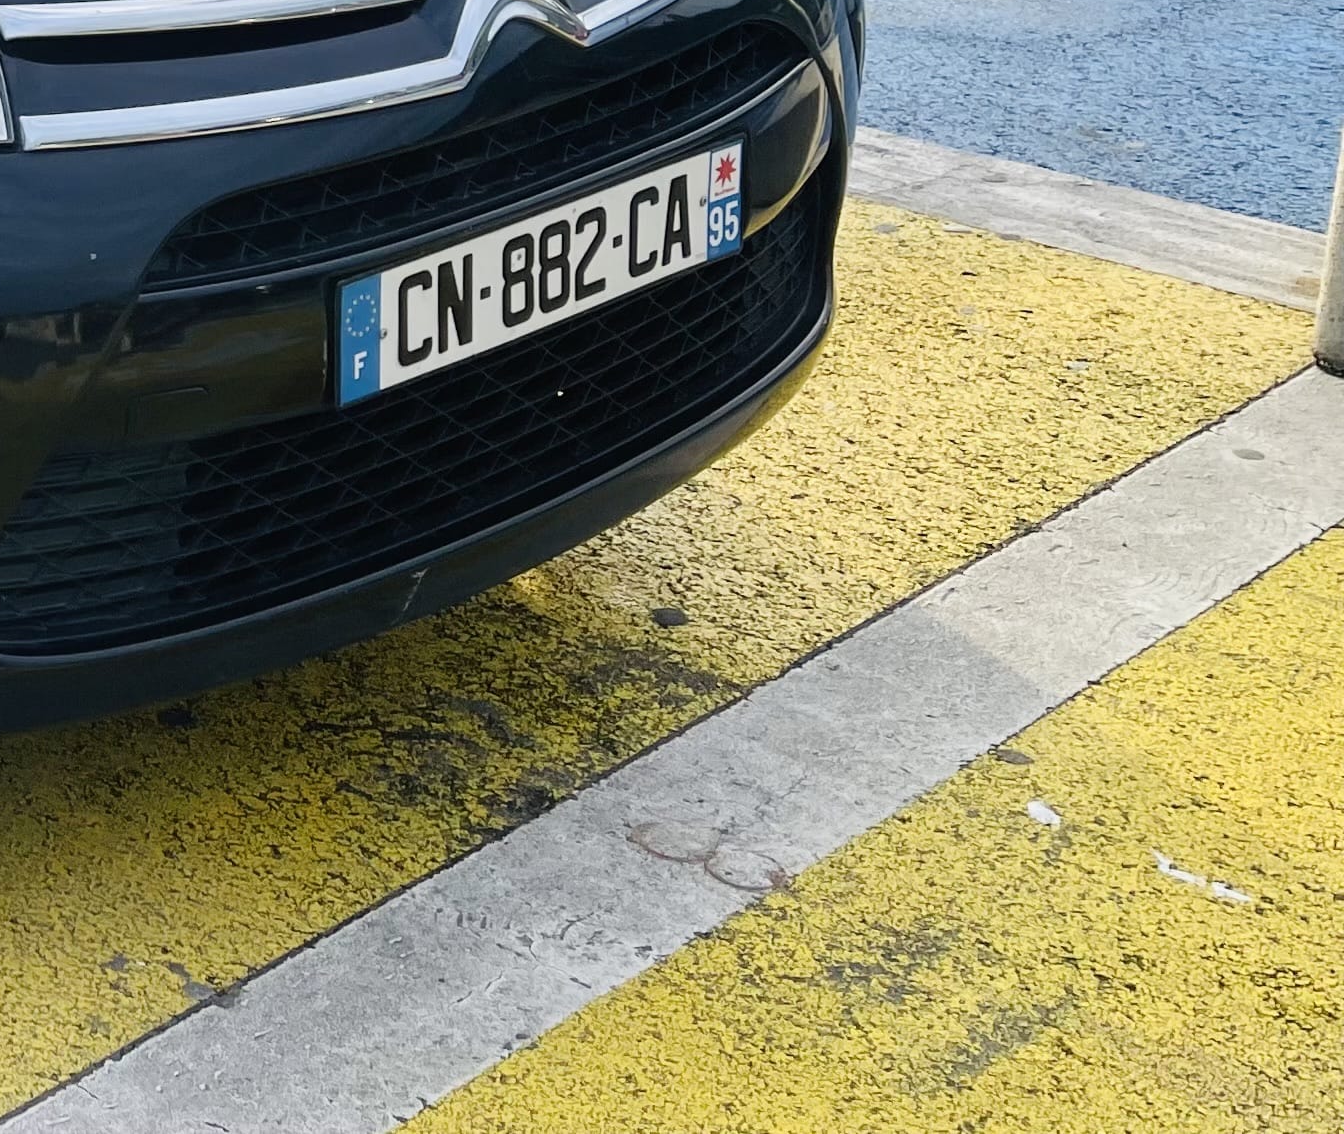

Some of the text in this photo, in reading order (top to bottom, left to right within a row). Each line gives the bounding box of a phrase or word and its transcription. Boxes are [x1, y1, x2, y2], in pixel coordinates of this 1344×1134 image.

[709, 199, 740, 248] 95
[397, 173, 692, 368] CN-882-CA
[352, 350, 368, 380] F
